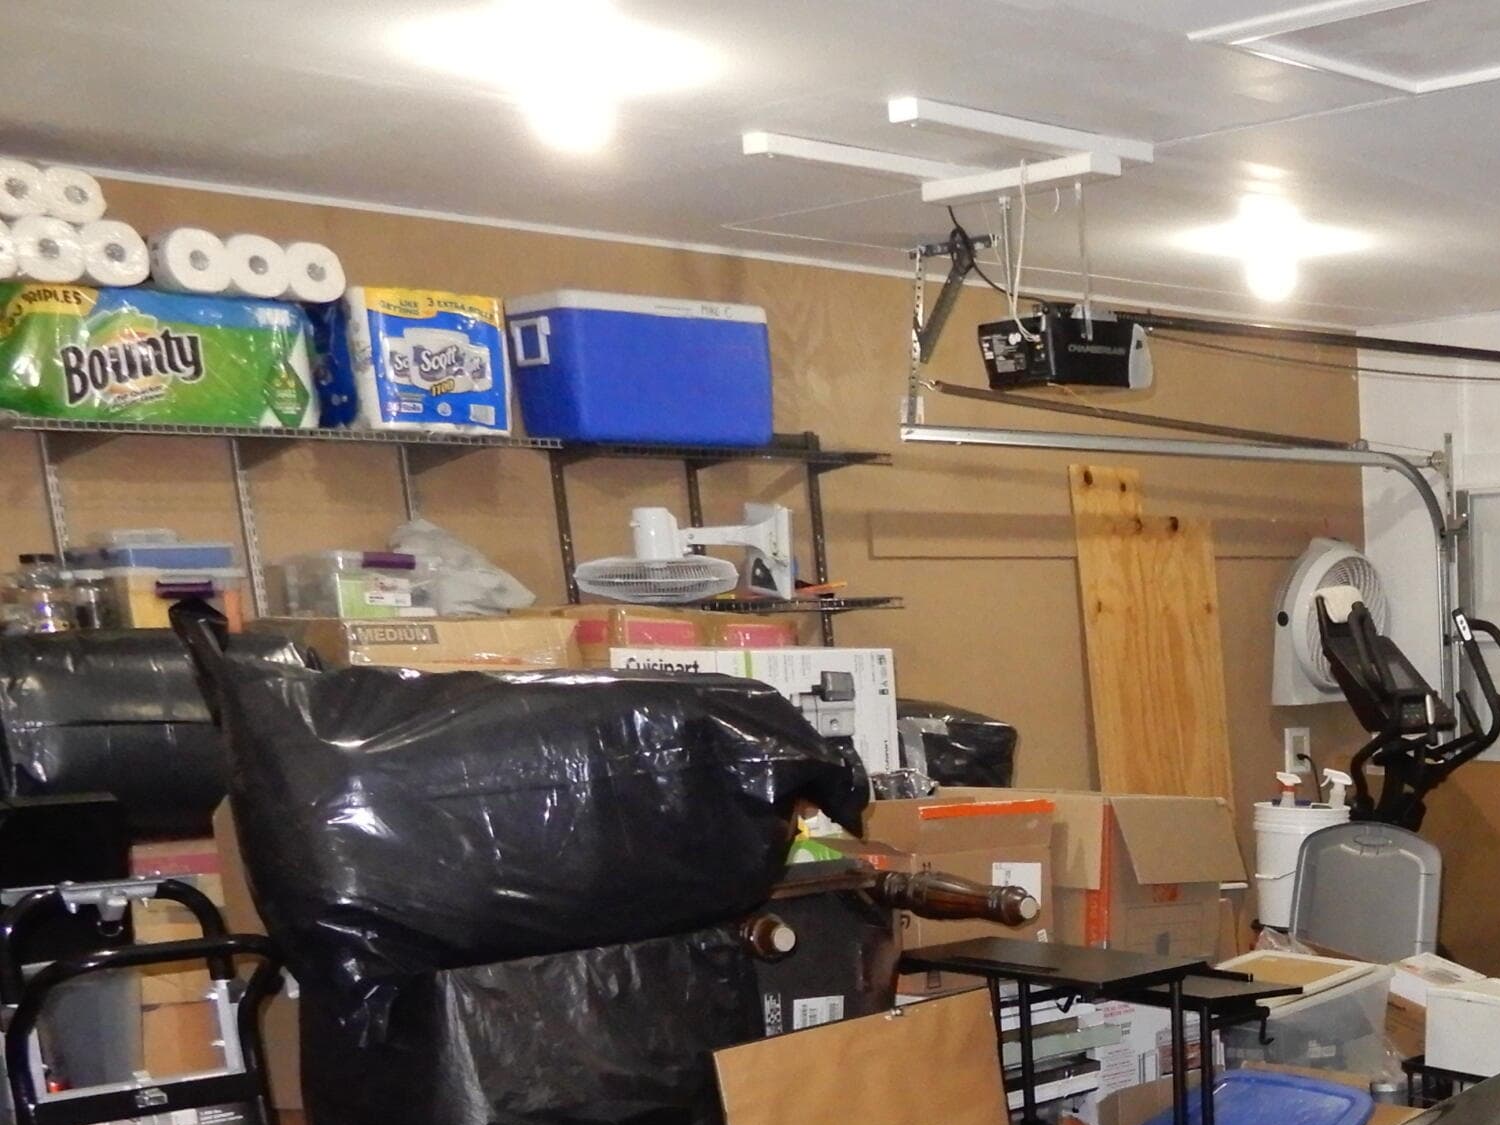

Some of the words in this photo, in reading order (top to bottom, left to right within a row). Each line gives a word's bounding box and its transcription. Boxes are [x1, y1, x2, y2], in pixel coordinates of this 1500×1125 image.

[60, 329, 202, 405] Bounty
[420, 345, 459, 373] Scott
[358, 627, 432, 642] MEDIUM
